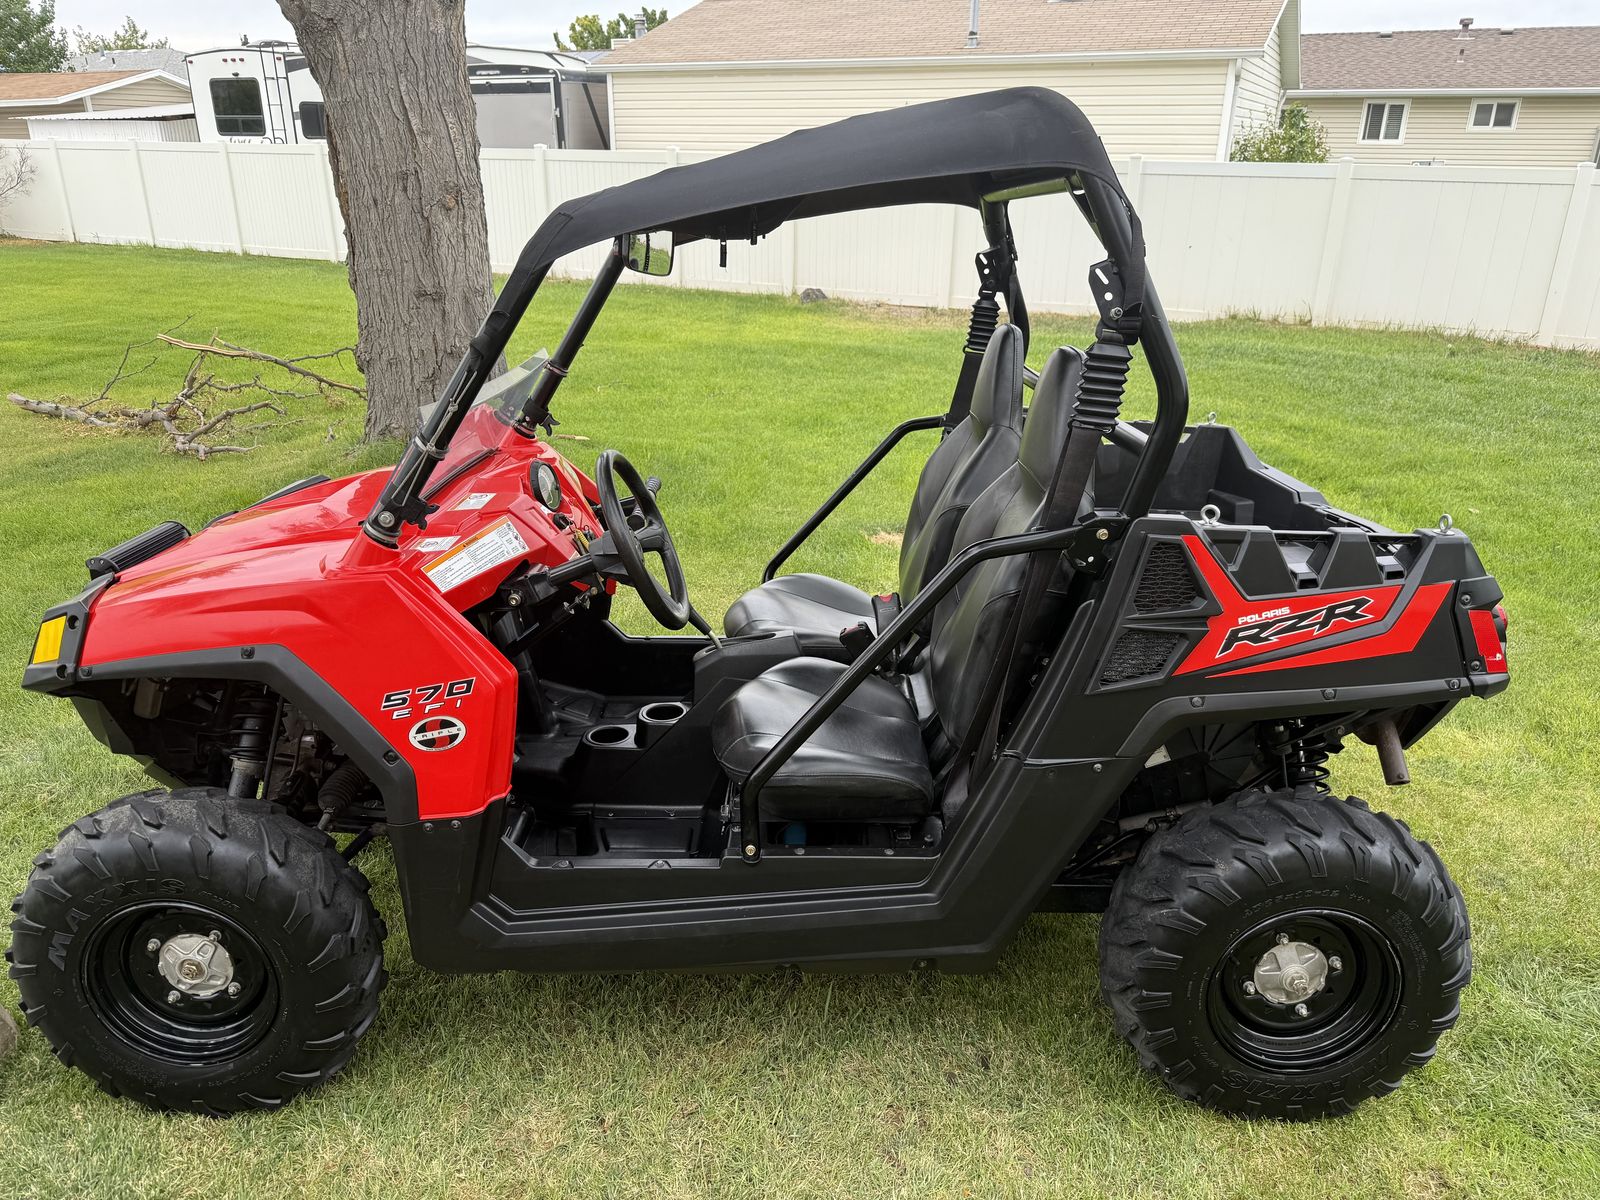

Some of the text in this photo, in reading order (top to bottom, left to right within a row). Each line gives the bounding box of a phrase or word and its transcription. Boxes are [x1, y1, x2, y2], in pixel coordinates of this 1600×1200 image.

[1215, 595, 1375, 659] RZR
[1238, 606, 1291, 625] POLARIS
[380, 677, 476, 711] 570
[392, 699, 462, 720] EFI
[47, 878, 186, 972] MAXXIS
